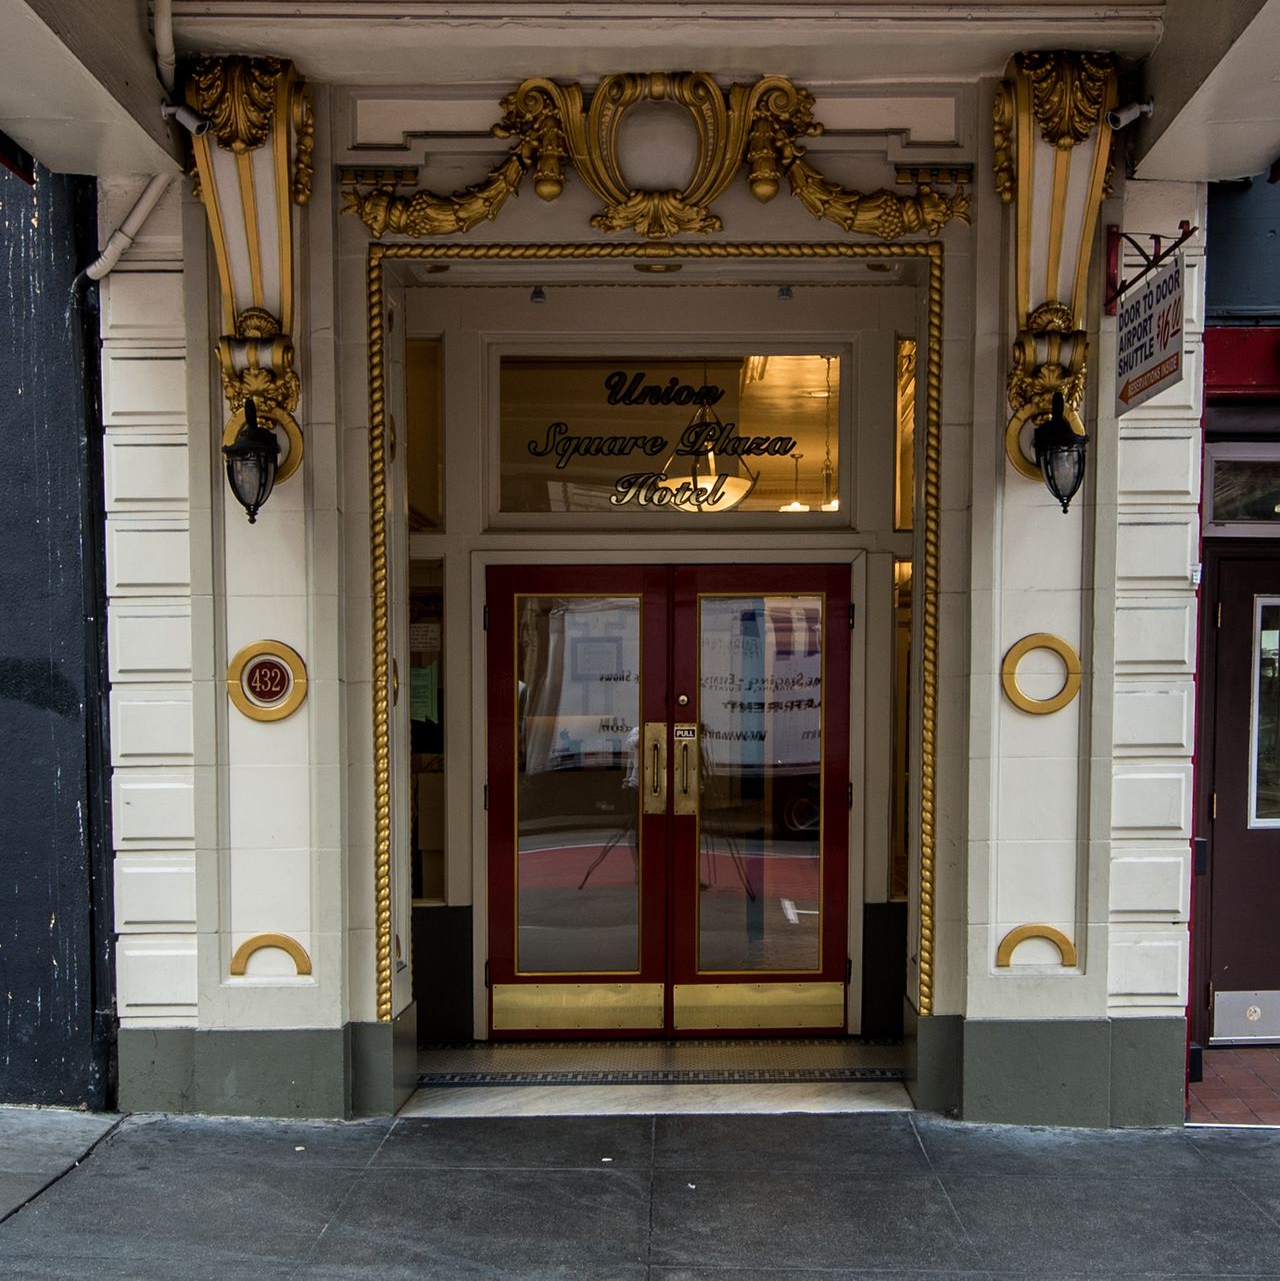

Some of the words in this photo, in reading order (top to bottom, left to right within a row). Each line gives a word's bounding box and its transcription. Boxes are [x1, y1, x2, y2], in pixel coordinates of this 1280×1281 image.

[1119, 304, 1140, 332] DOOR
[1143, 289, 1154, 314] TO
[1156, 269, 1180, 304] DOOR
[1119, 314, 1154, 356] AIRPORT
[1118, 336, 1154, 377] SHUTTLE
[605, 371, 725, 406] Union
[528, 421, 668, 469] Square
[676, 421, 797, 456] Plaza
[610, 472, 729, 506] Hotel
[251, 668, 281, 691] 432
